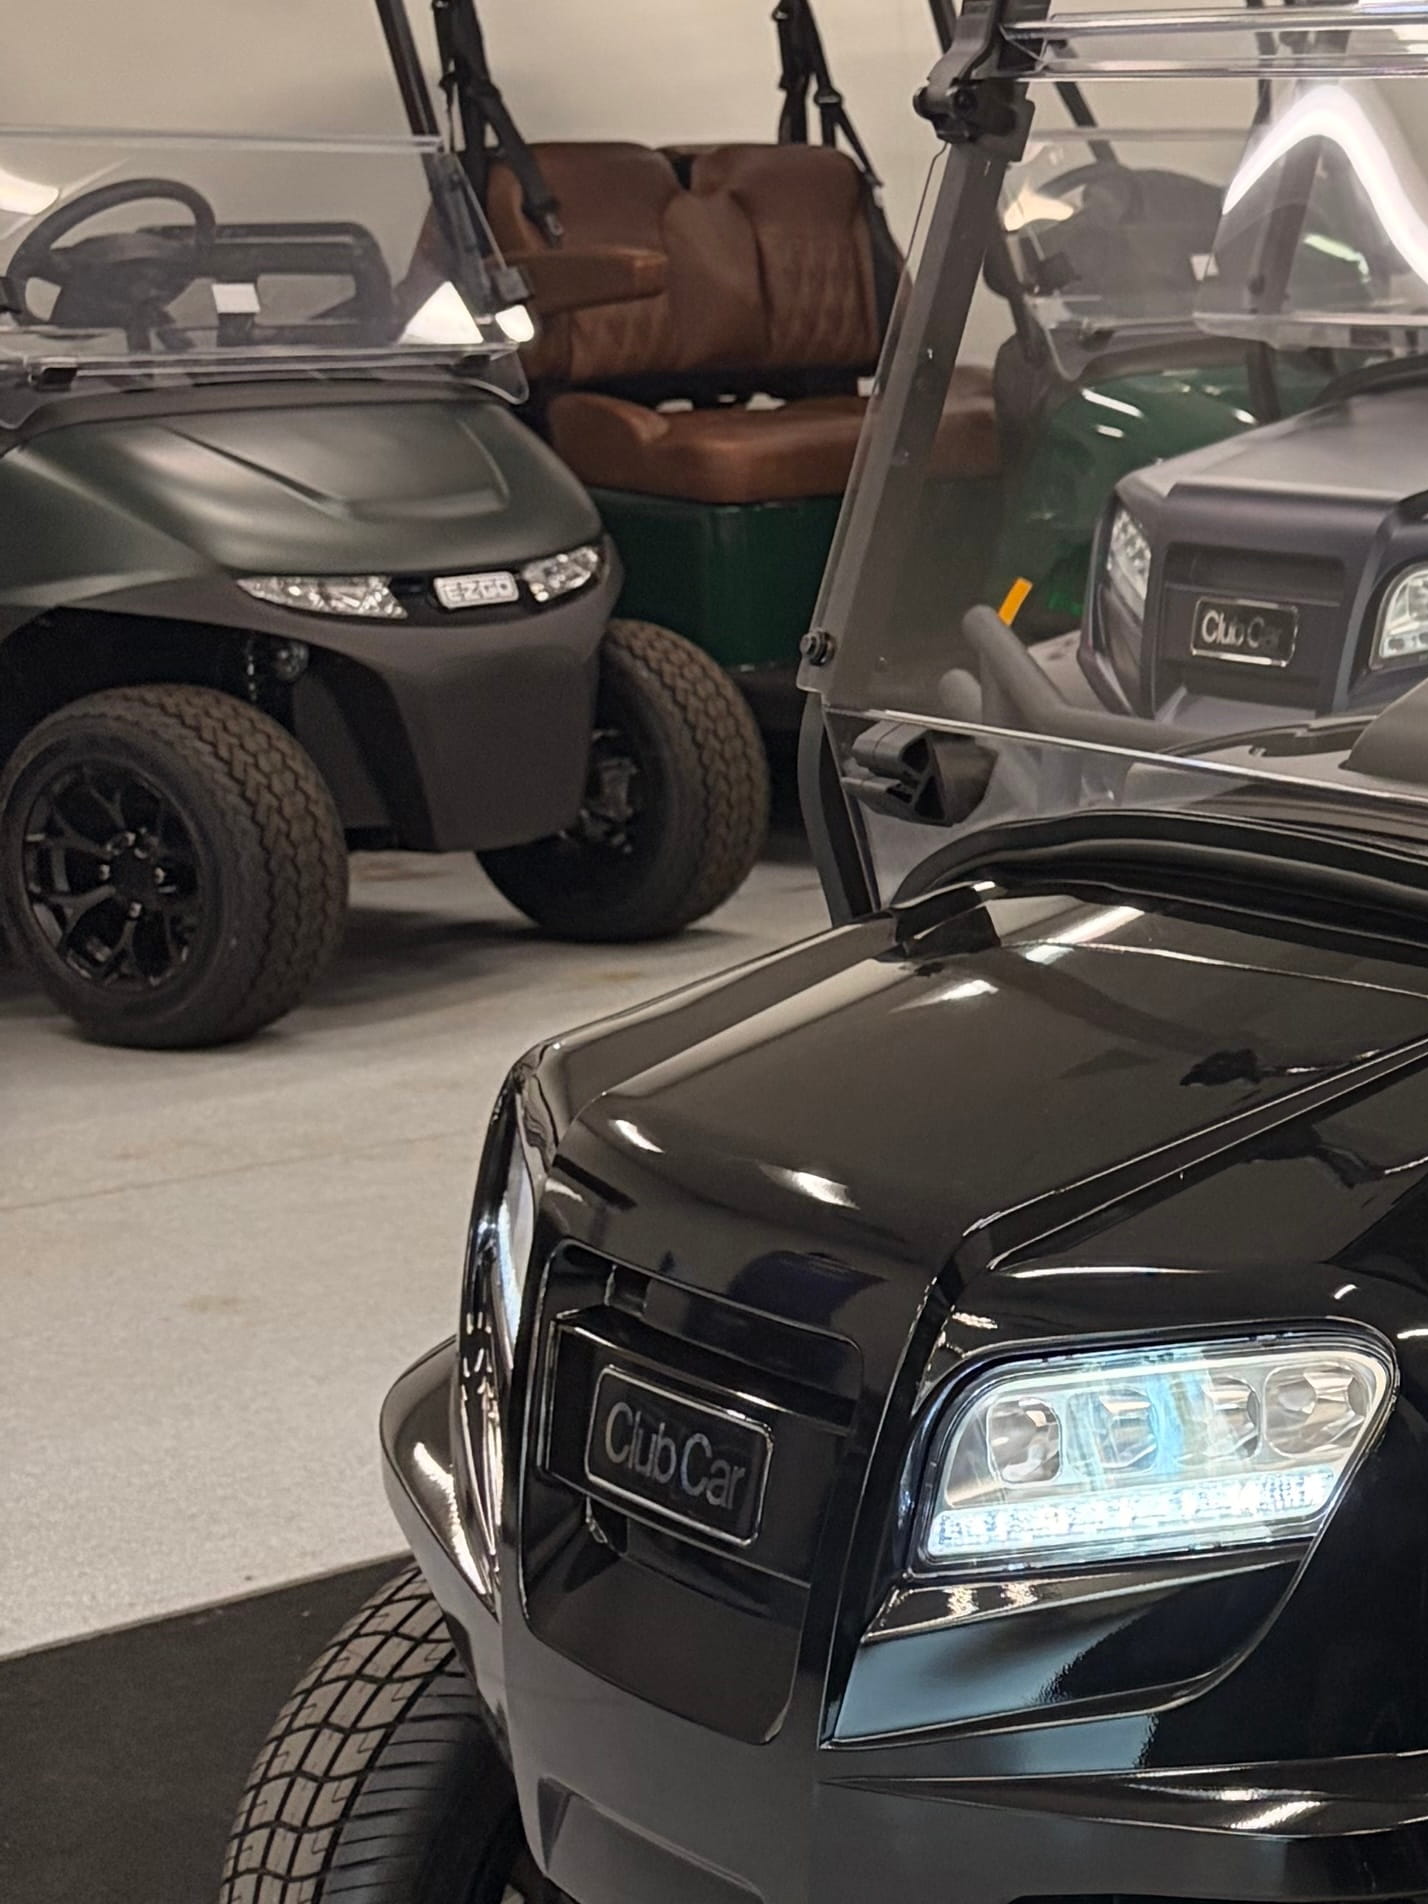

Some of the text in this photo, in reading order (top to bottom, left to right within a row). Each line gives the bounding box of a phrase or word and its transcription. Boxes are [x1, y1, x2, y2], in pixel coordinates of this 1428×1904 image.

[1201, 609, 1245, 648] Club
[605, 1402, 746, 1510] Club Car
